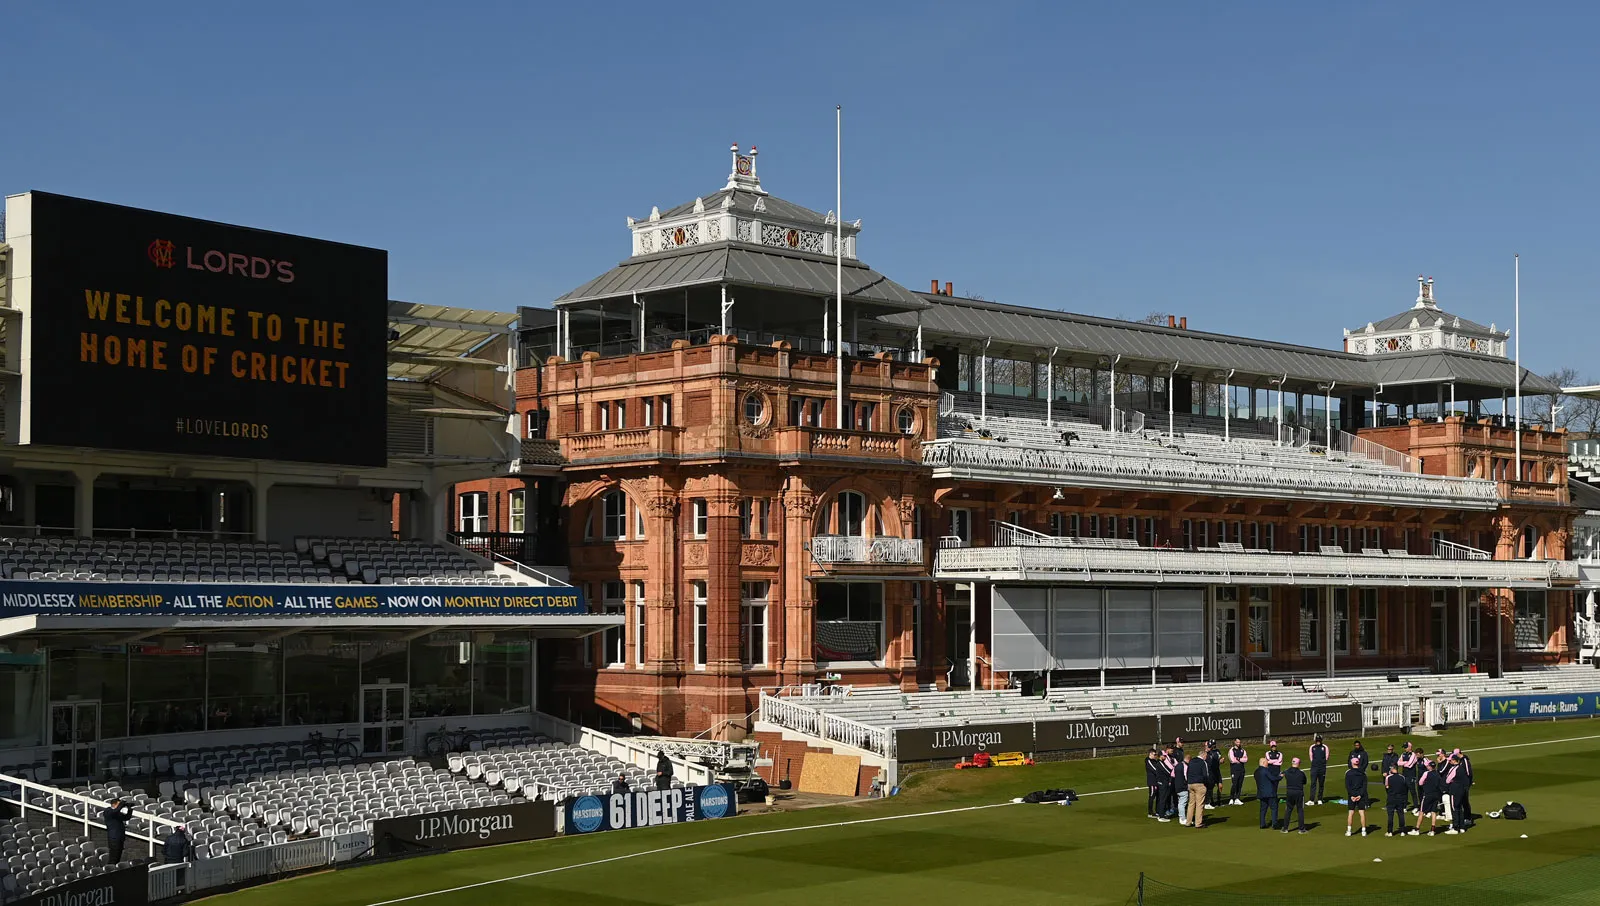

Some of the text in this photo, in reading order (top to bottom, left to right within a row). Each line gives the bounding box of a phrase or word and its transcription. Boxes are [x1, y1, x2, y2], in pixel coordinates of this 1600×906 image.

[187, 246, 295, 283] LORD'S
[85, 289, 346, 350] WELCOME TO THE
[80, 332, 349, 389] HOME OF CRICKET
[176, 417, 269, 439] #LOVELORDS
[3, 593, 76, 608] MIDDLESEX
[79, 594, 163, 608] MEMBERSHIP
[173, 595, 196, 608] ALL
[197, 595, 223, 608] THE
[225, 595, 273, 608] ACTION
[284, 596, 306, 608] ALL
[308, 596, 332, 609] THE
[335, 596, 378, 609] GAMES
[388, 596, 419, 608] NOW
[421, 596, 442, 608] ON
[444, 596, 500, 608] MONTHLY
[504, 596, 544, 608] DIRECT
[547, 596, 578, 608] DEBIT
[1185, 716, 1242, 735] J.P.Morgan
[1292, 710, 1342, 728] J.P.Morgan
[932, 730, 1002, 751] J.P.Morgan
[1066, 722, 1130, 742] J.P.Morgan
[609, 788, 683, 829] 61 DEEP
[685, 786, 695, 821] PALE ALE
[415, 814, 514, 840] J.P.Morgan
